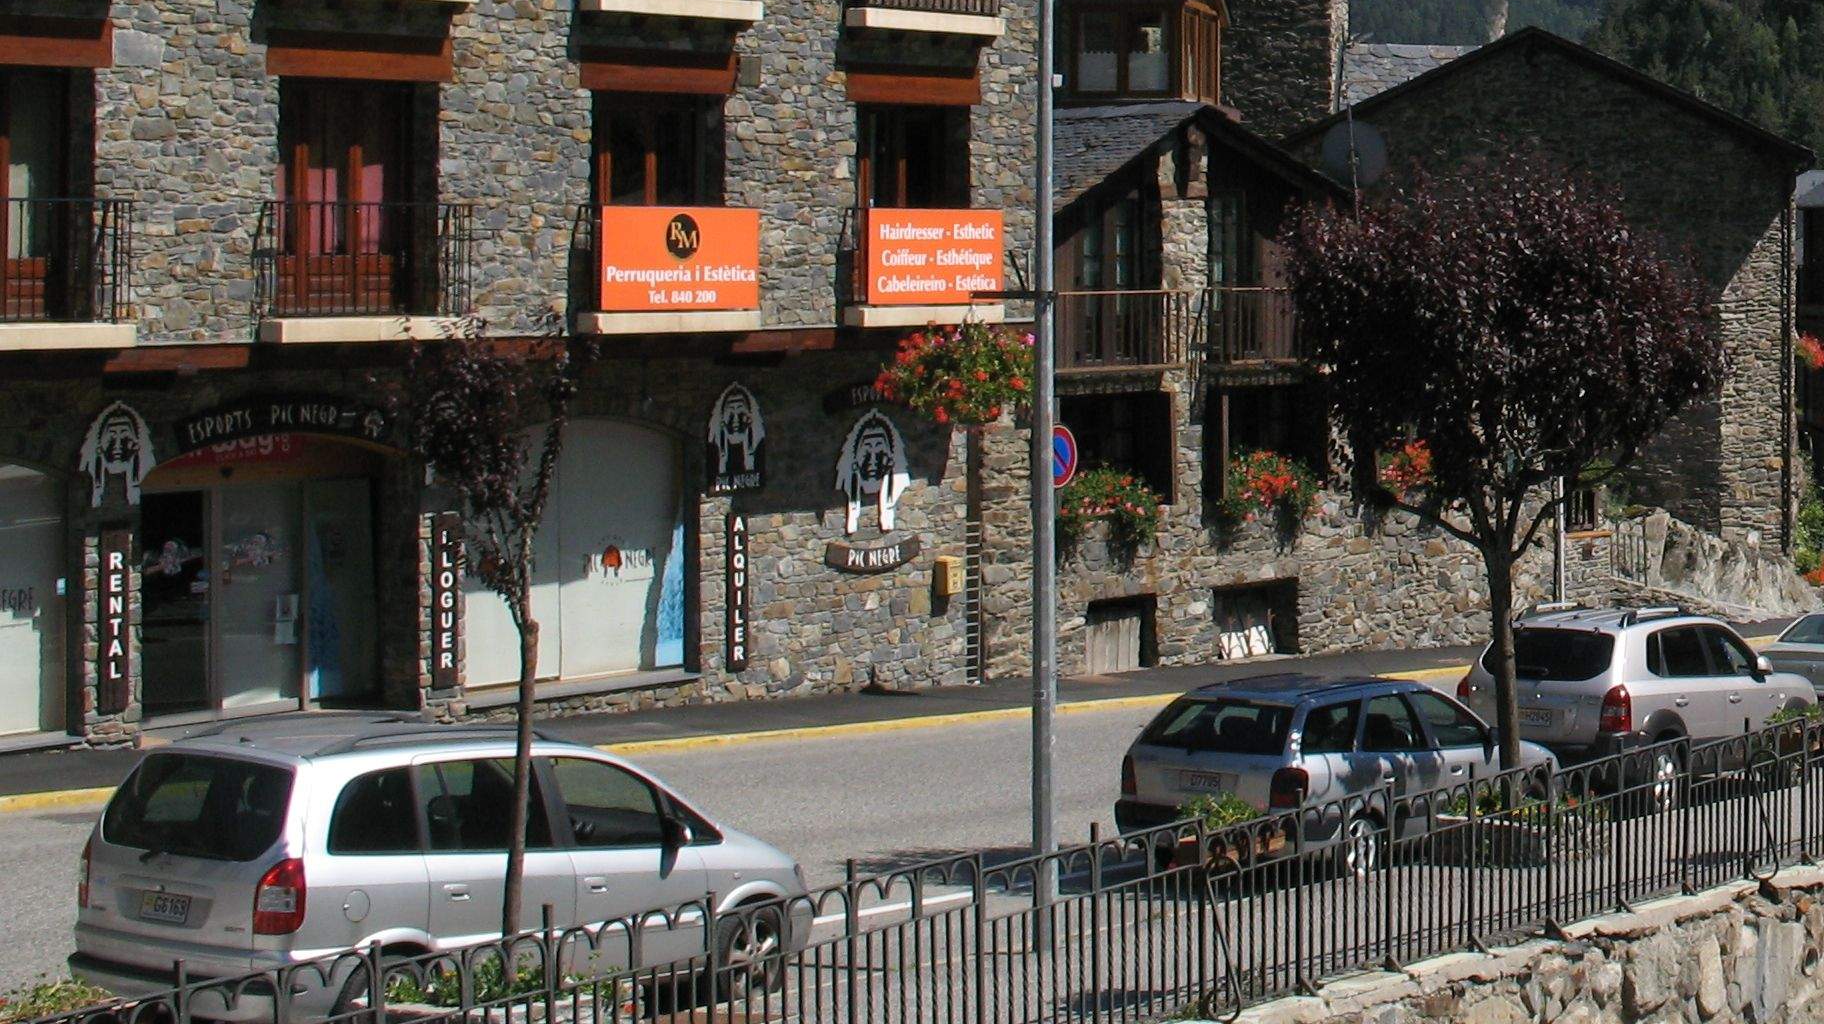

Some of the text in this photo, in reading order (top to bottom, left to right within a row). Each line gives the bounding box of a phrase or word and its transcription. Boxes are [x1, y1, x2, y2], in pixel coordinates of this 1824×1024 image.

[880, 222, 945, 240] Hairdresser
[953, 222, 995, 240] Esthetic
[881, 249, 927, 266] Coiffeur
[936, 247, 993, 271] Esthétique
[606, 264, 756, 288] Perruqueria i Estètica
[877, 275, 946, 293] Cabeleireiro
[955, 273, 997, 291] Estética
[648, 289, 717, 304] Tel. 840 200
[188, 409, 251, 443] ESPORTS
[869, 544, 901, 567] NEGRE
[733, 516, 744, 661] ALQUILER
[109, 552, 123, 679] RENTAL
